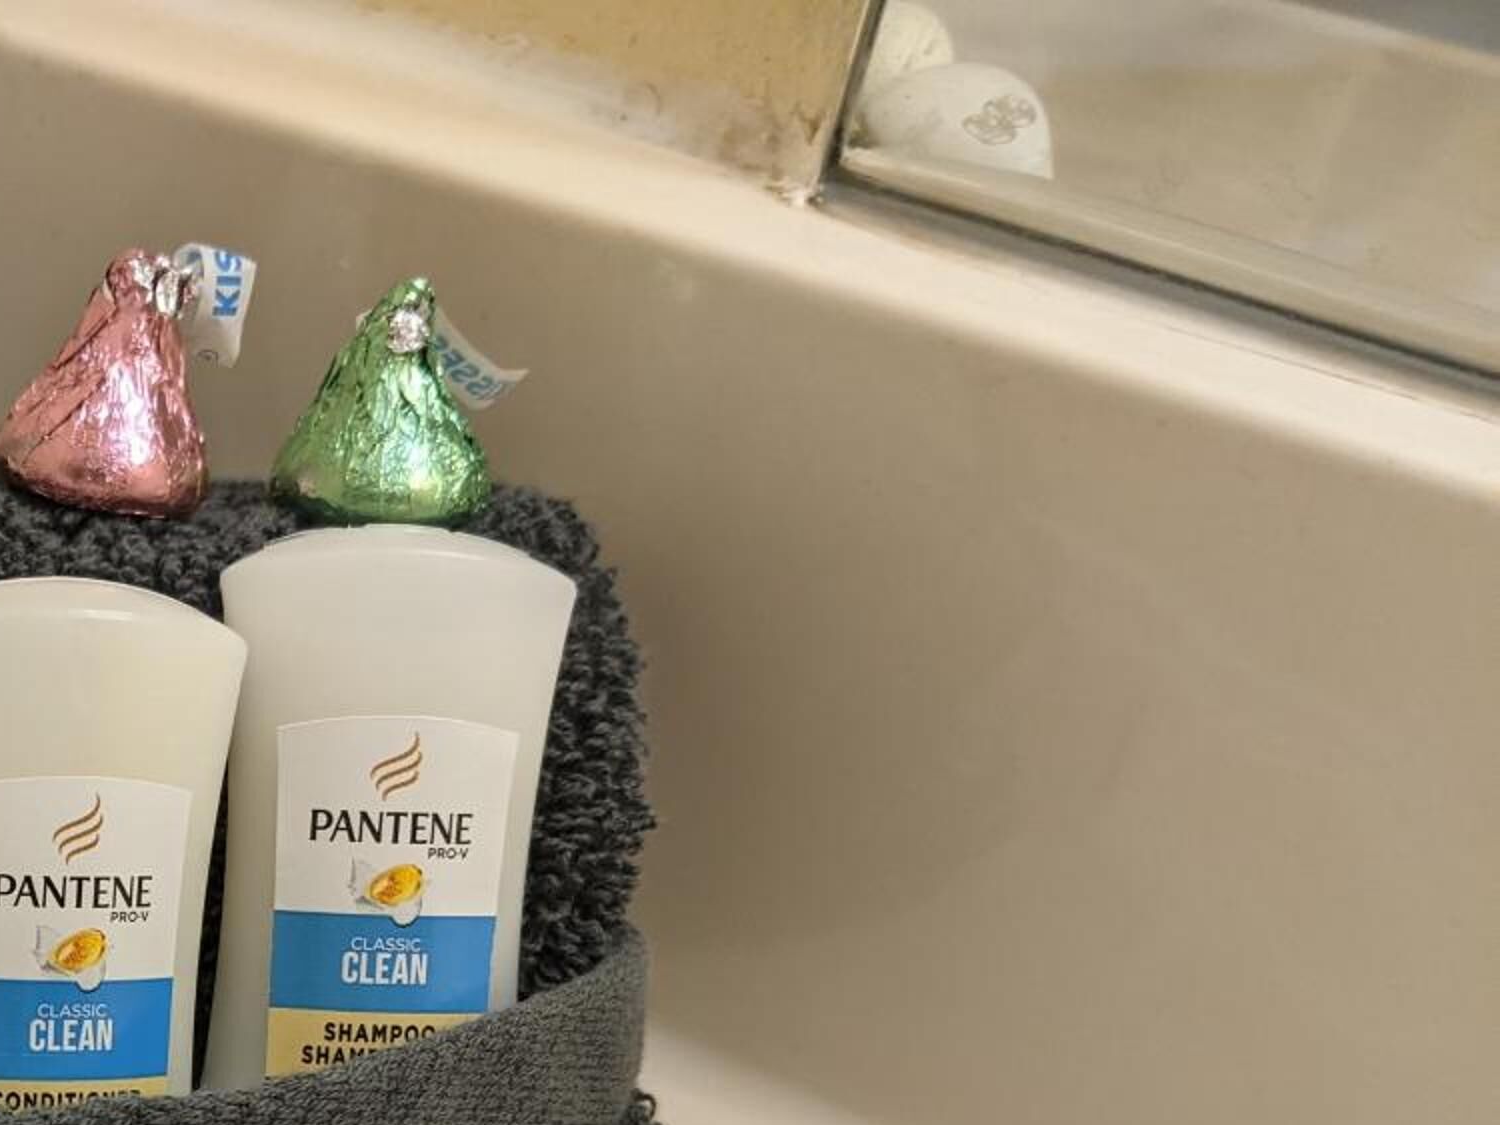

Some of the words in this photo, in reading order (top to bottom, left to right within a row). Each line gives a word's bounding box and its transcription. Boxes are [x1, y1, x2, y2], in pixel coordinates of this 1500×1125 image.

[309, 809, 474, 846] PANTENE
[351, 937, 422, 952] CLASSIC
[341, 952, 428, 985] CLEAN
[37, 1003, 108, 1018] CLASSIC
[29, 1019, 114, 1052] CLEAN
